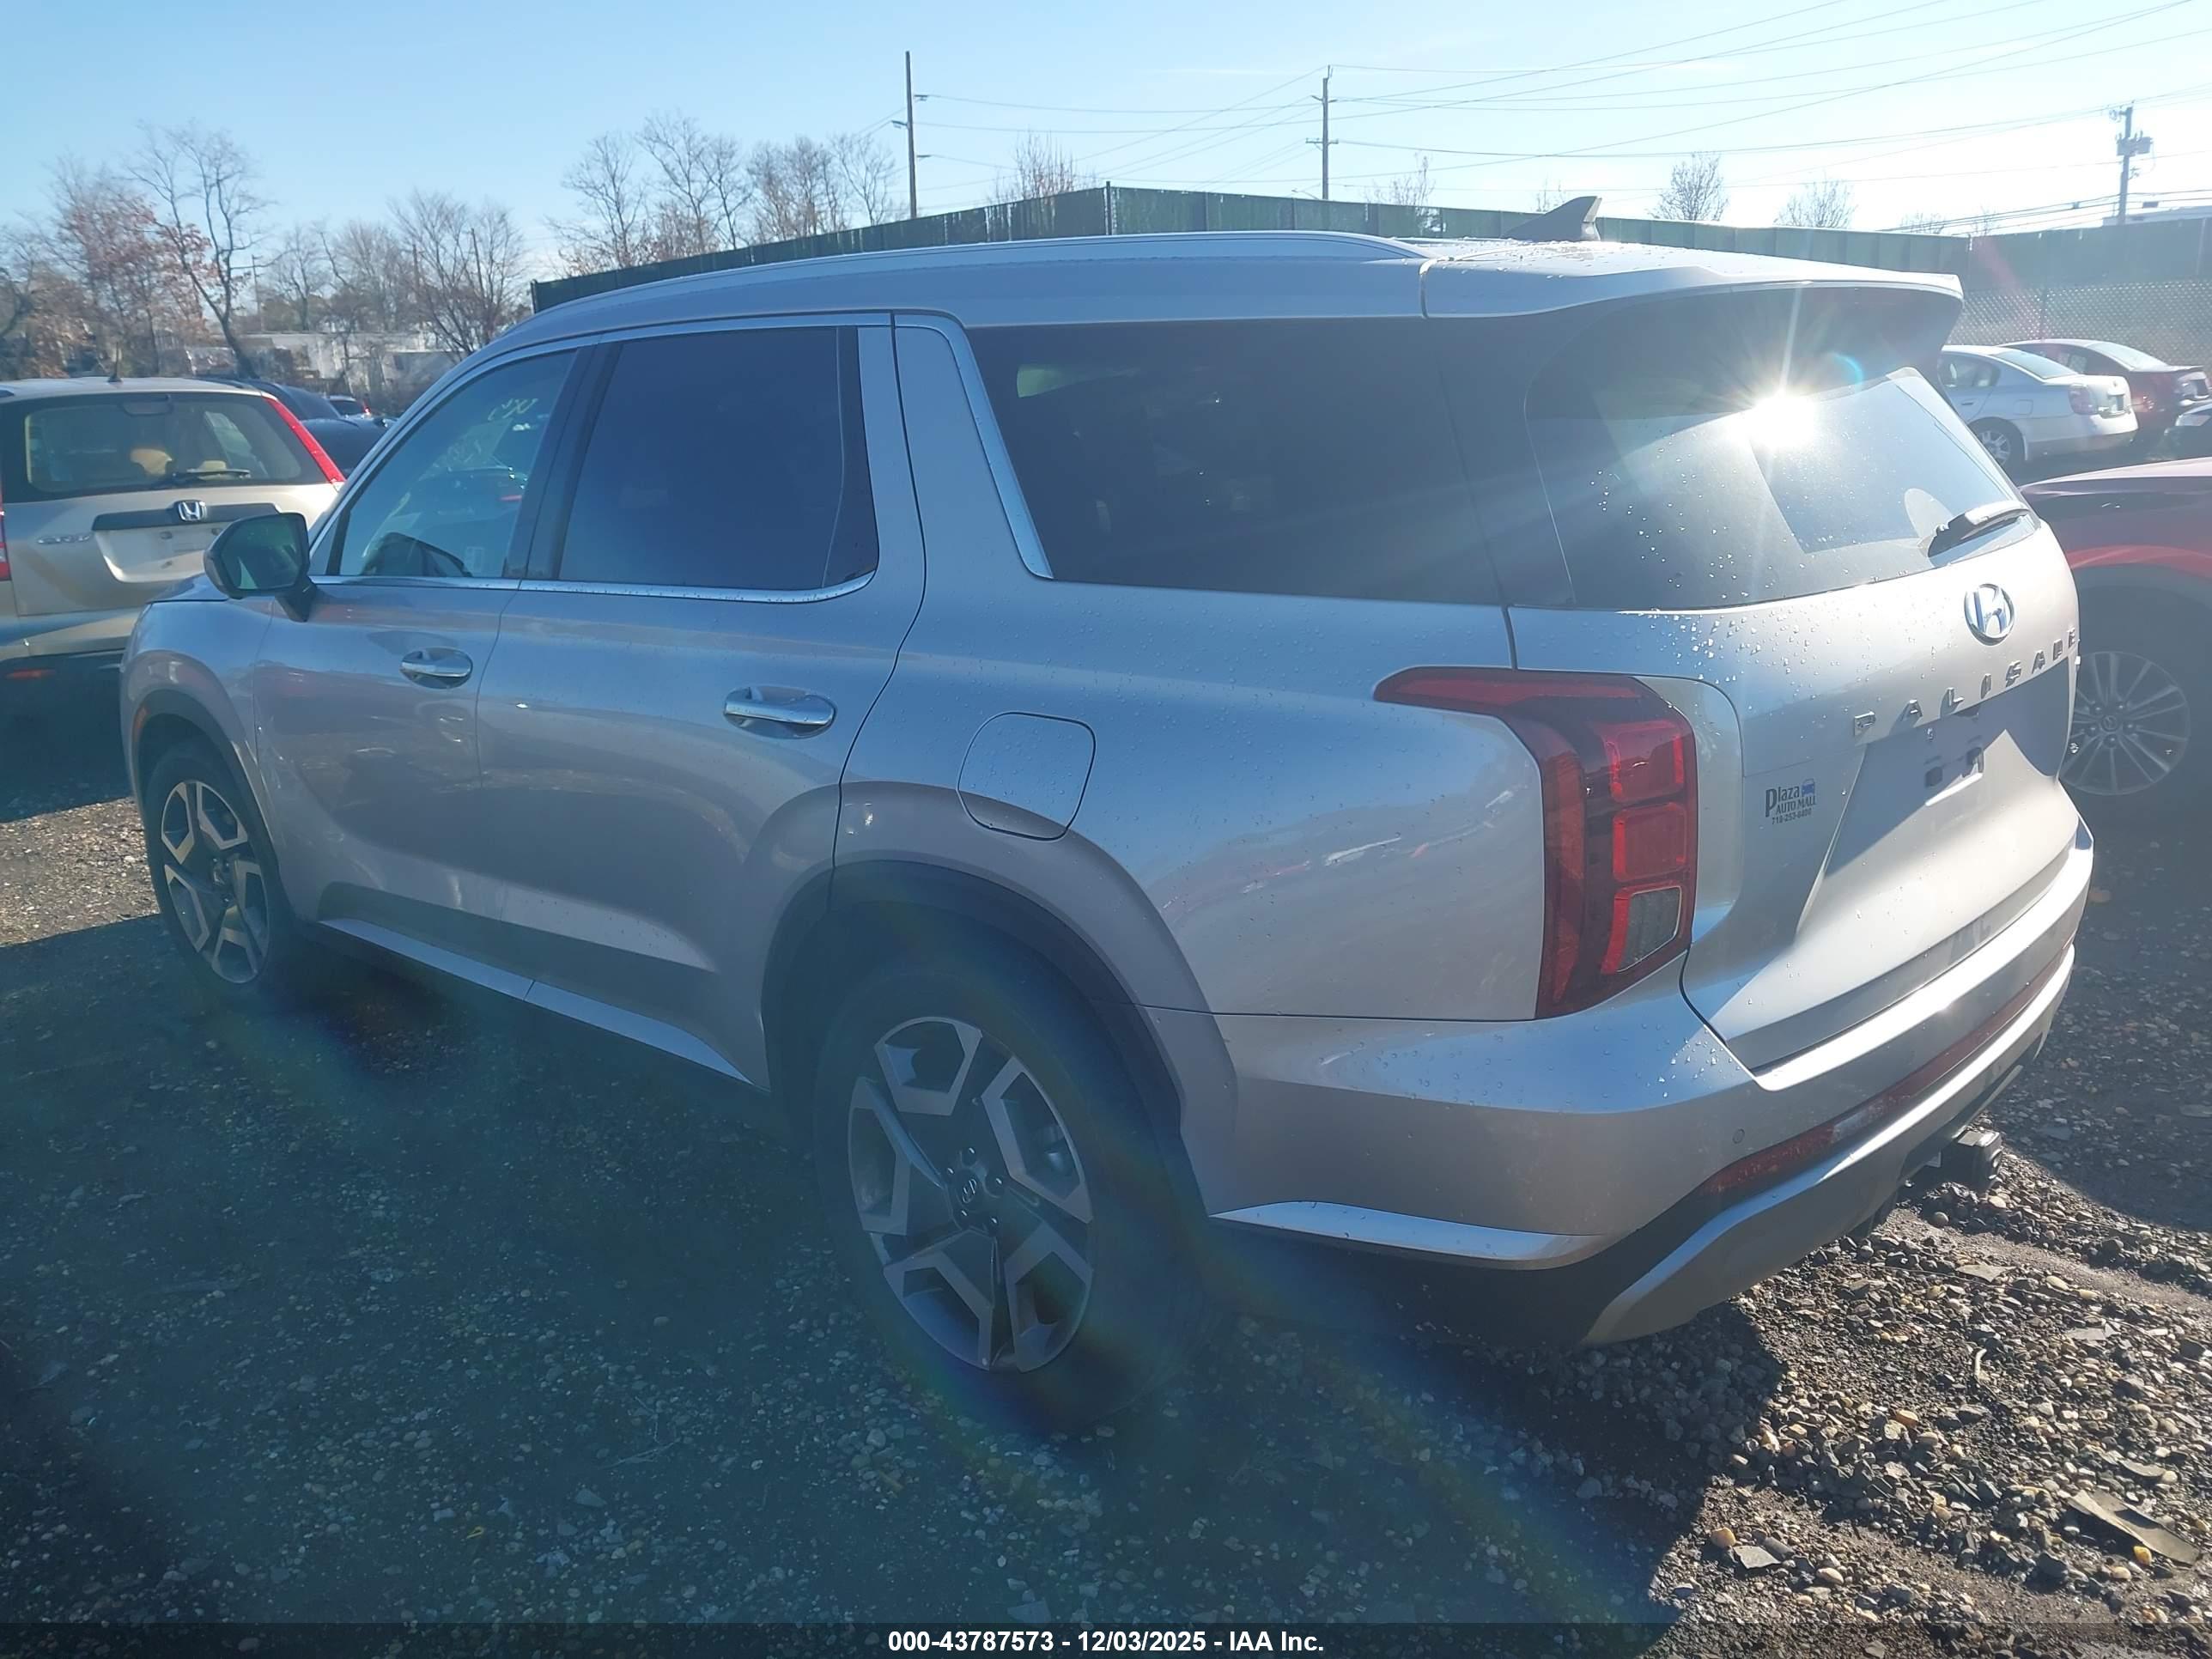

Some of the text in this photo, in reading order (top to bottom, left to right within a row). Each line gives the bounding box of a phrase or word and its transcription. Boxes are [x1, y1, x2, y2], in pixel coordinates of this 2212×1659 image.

[1854, 627, 2077, 737] PALISADE
[1765, 786, 1800, 818] Plaza
[1776, 796, 1817, 816] AUTO MALL
